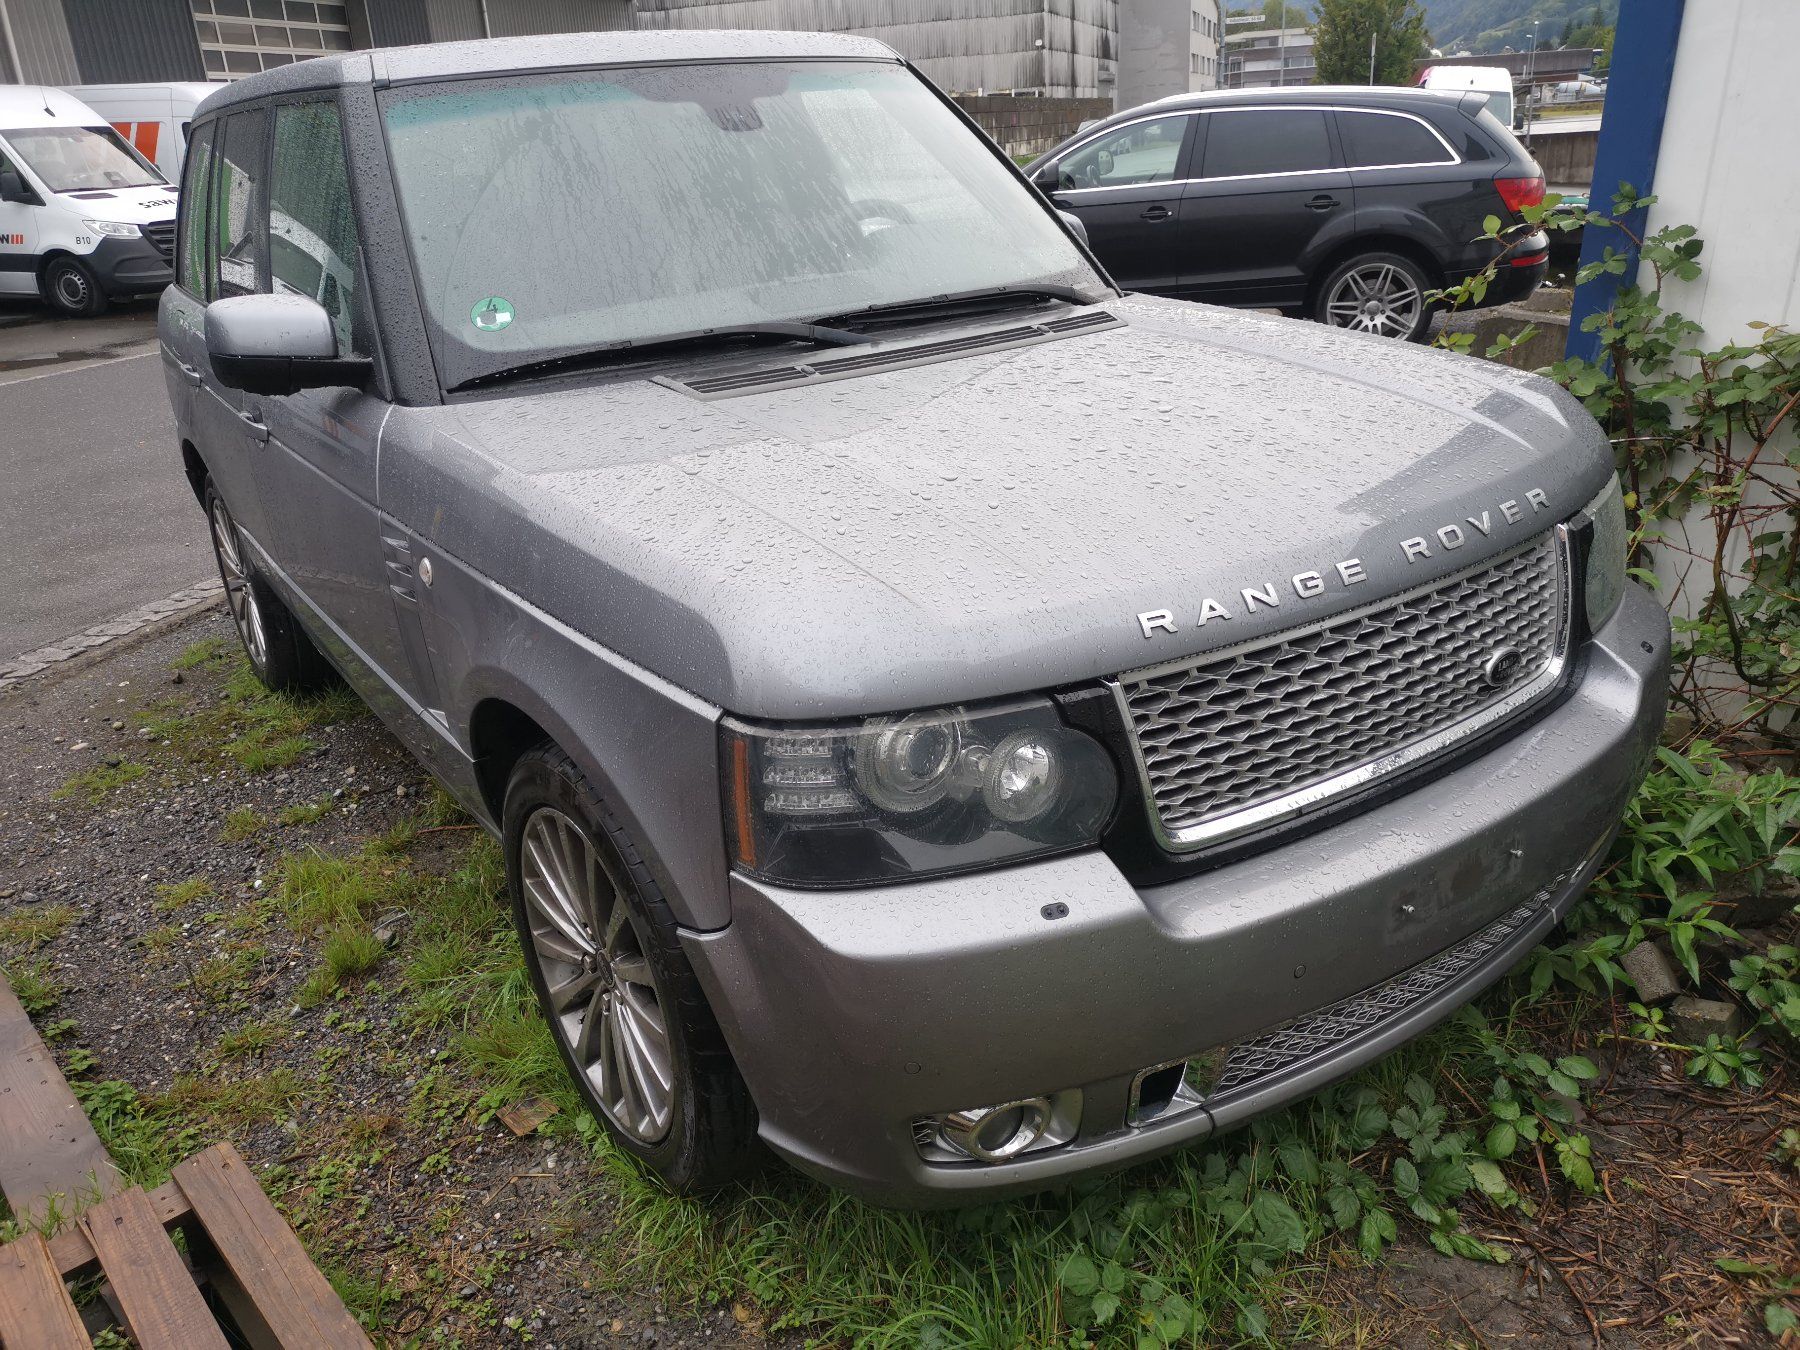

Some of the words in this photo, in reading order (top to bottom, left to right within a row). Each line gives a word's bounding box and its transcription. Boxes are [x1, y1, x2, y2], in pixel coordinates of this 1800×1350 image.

[75, 236, 91, 245] B10
[1137, 557, 1368, 638] RANGE
[1400, 487, 1552, 564] ROVER
